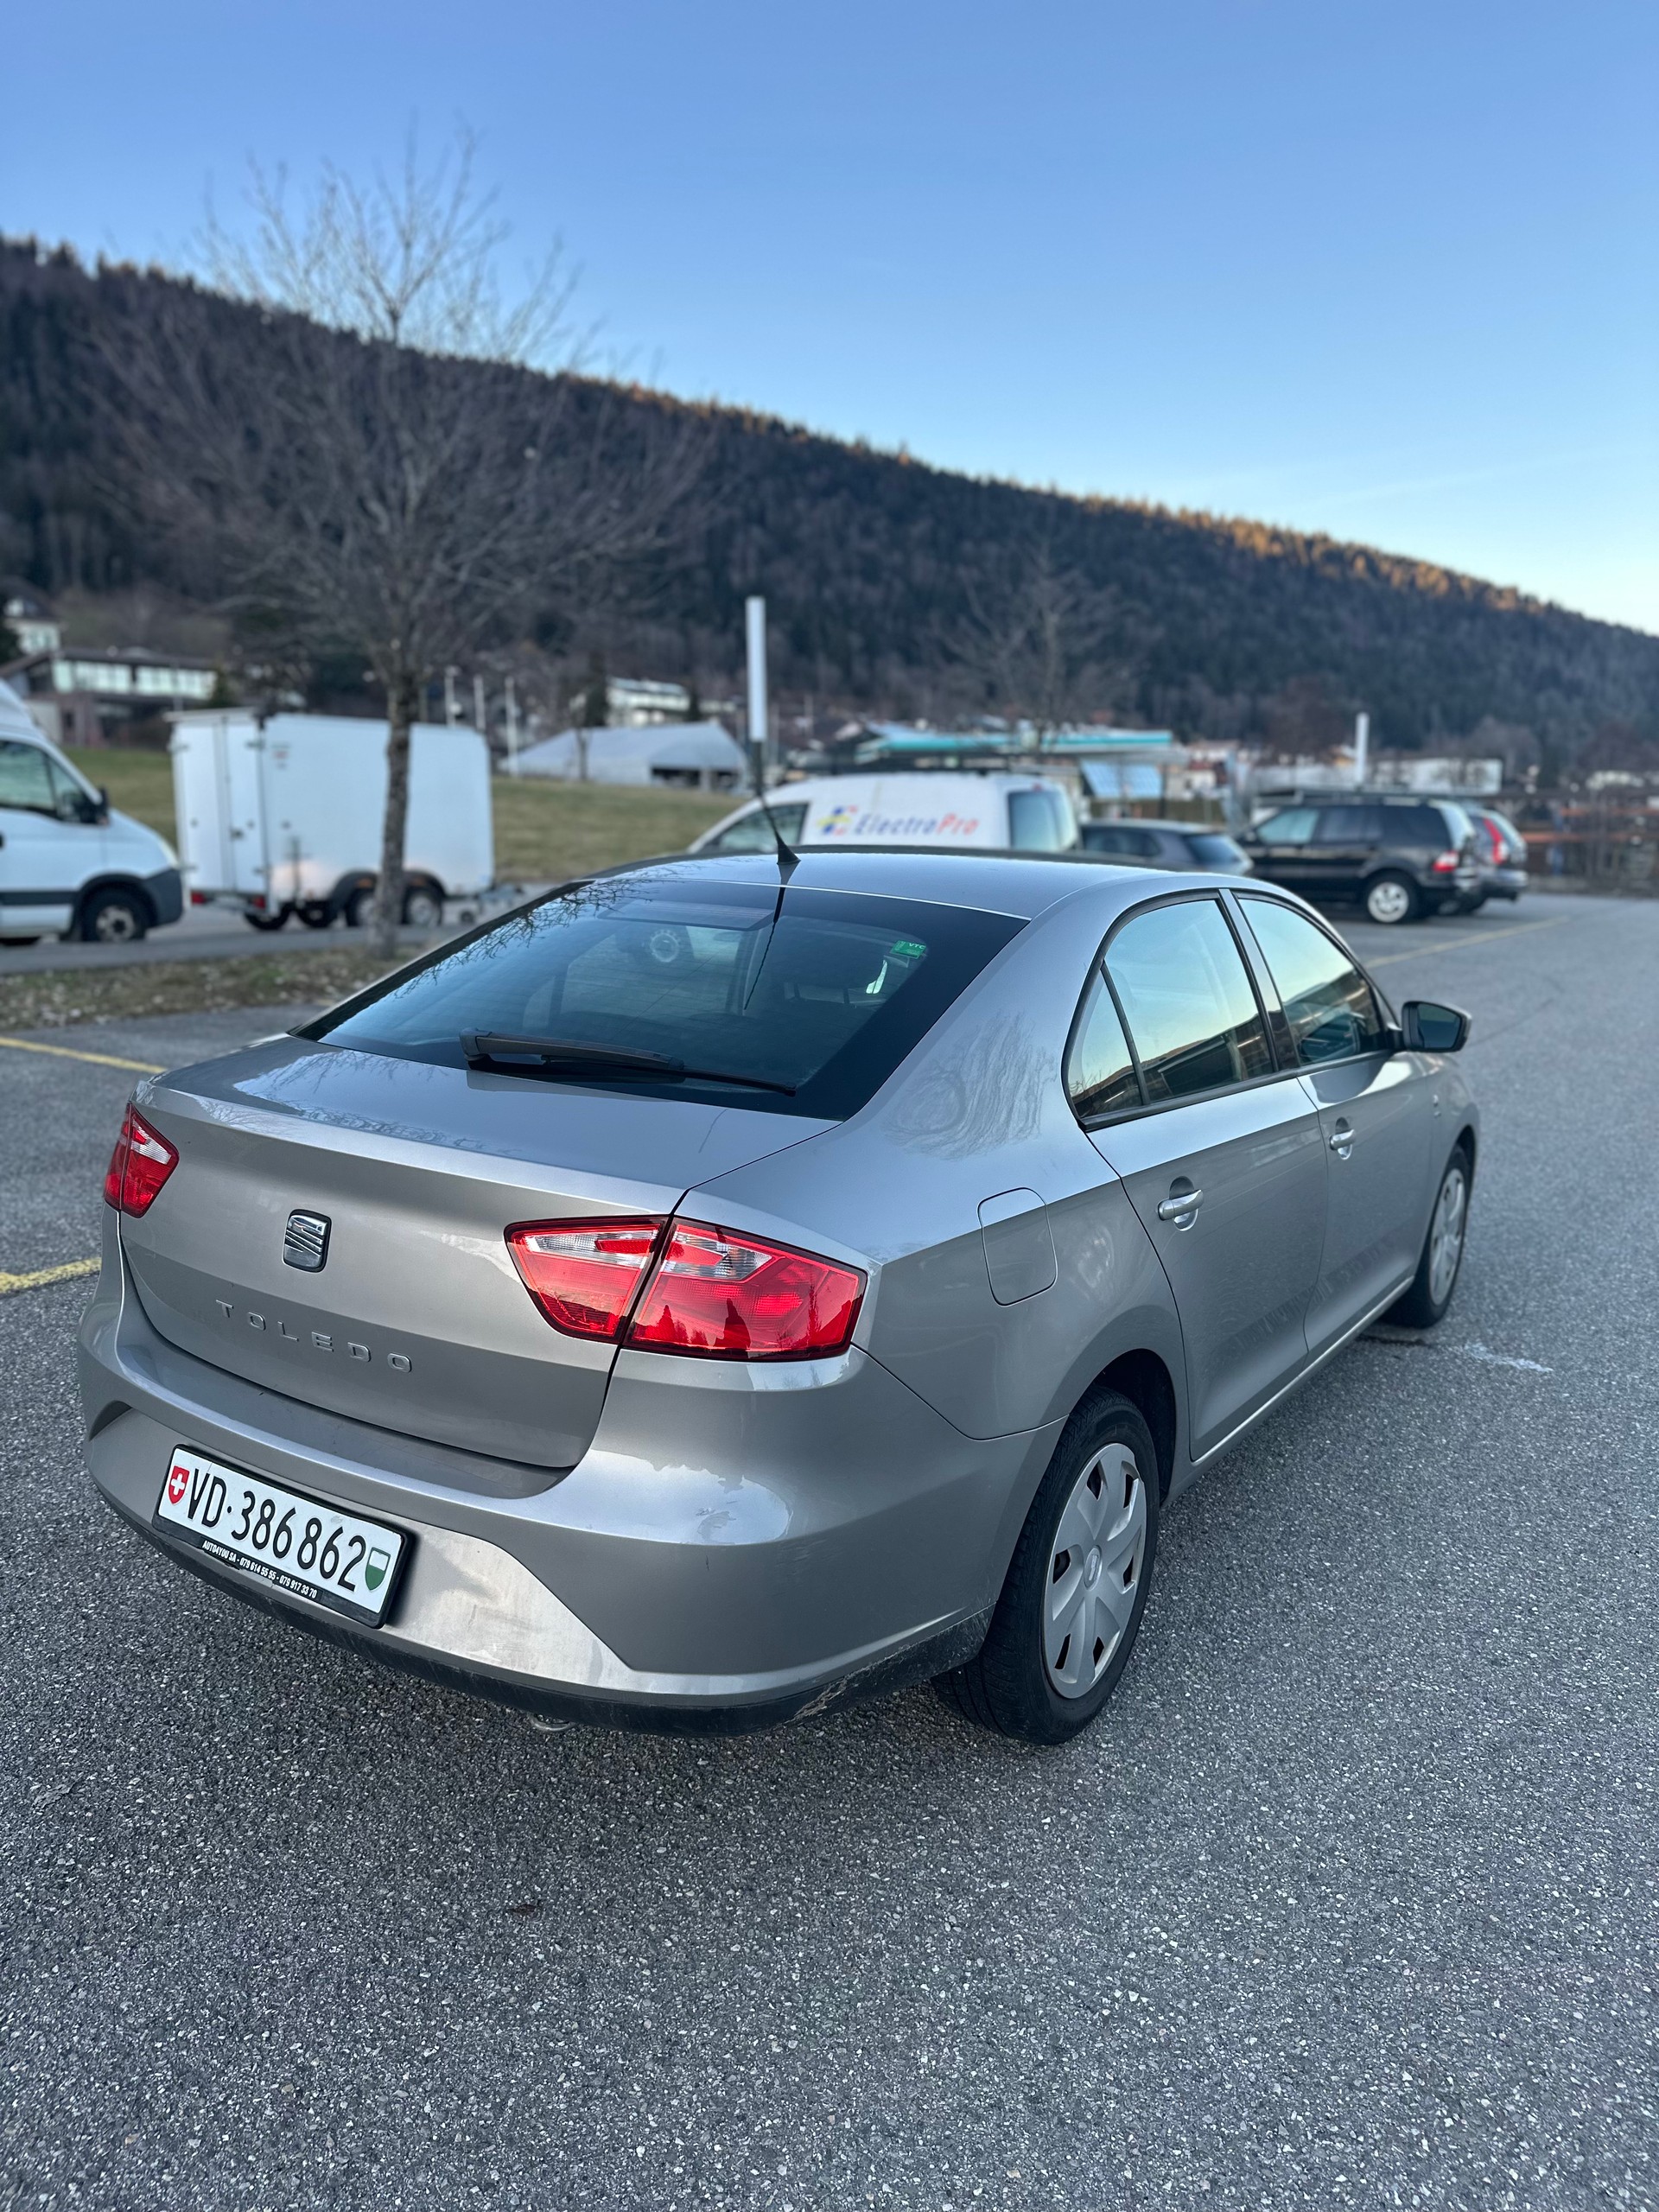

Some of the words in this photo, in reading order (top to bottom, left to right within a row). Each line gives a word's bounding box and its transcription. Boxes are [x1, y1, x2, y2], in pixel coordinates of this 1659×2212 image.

[855, 812, 980, 836] ElectroPro
[215, 1299, 412, 1373] TOLEDO
[202, 1540, 230, 1559] AUTO4YOU
[228, 1552, 237, 1562] SA
[239, 1557, 251, 1568] 079
[250, 1562, 261, 1573] 614
[260, 1567, 269, 1577] 55
[268, 1569, 276, 1580] 55
[279, 1574, 291, 1587] 079
[301, 1584, 309, 1595] 33
[308, 1587, 318, 1599] 70
